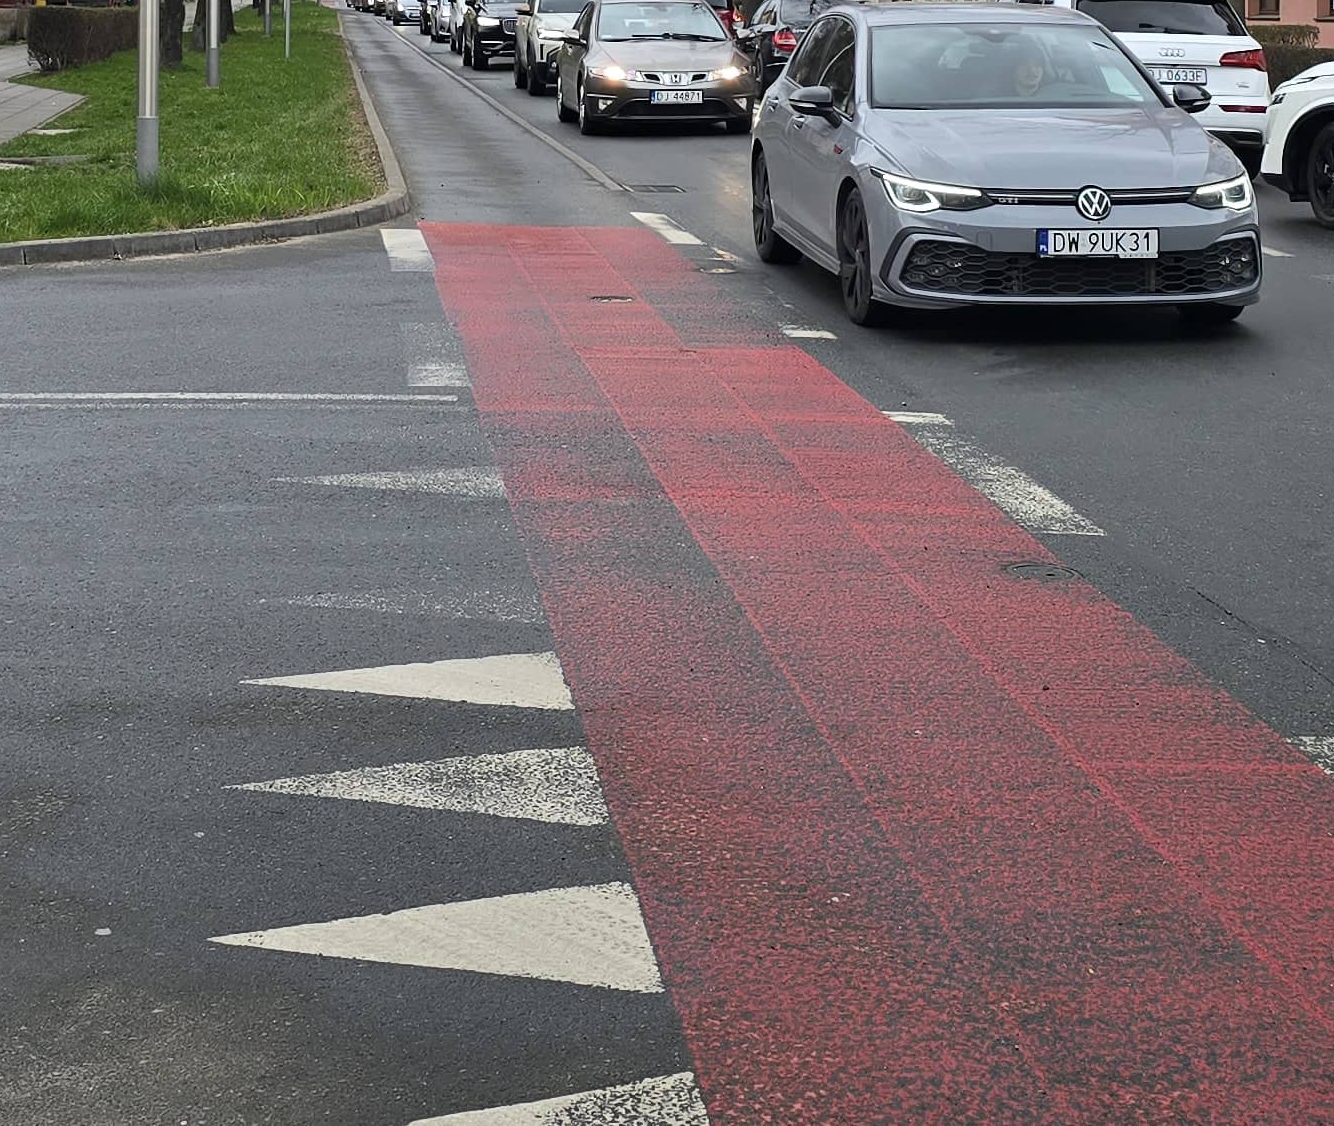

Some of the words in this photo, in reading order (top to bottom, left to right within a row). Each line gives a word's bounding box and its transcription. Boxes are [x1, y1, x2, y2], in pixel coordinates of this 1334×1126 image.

[657, 92, 668, 101] DJ
[673, 92, 700, 101] 44871
[1053, 232, 1080, 253] DW
[1088, 232, 1150, 253] 9UK31
